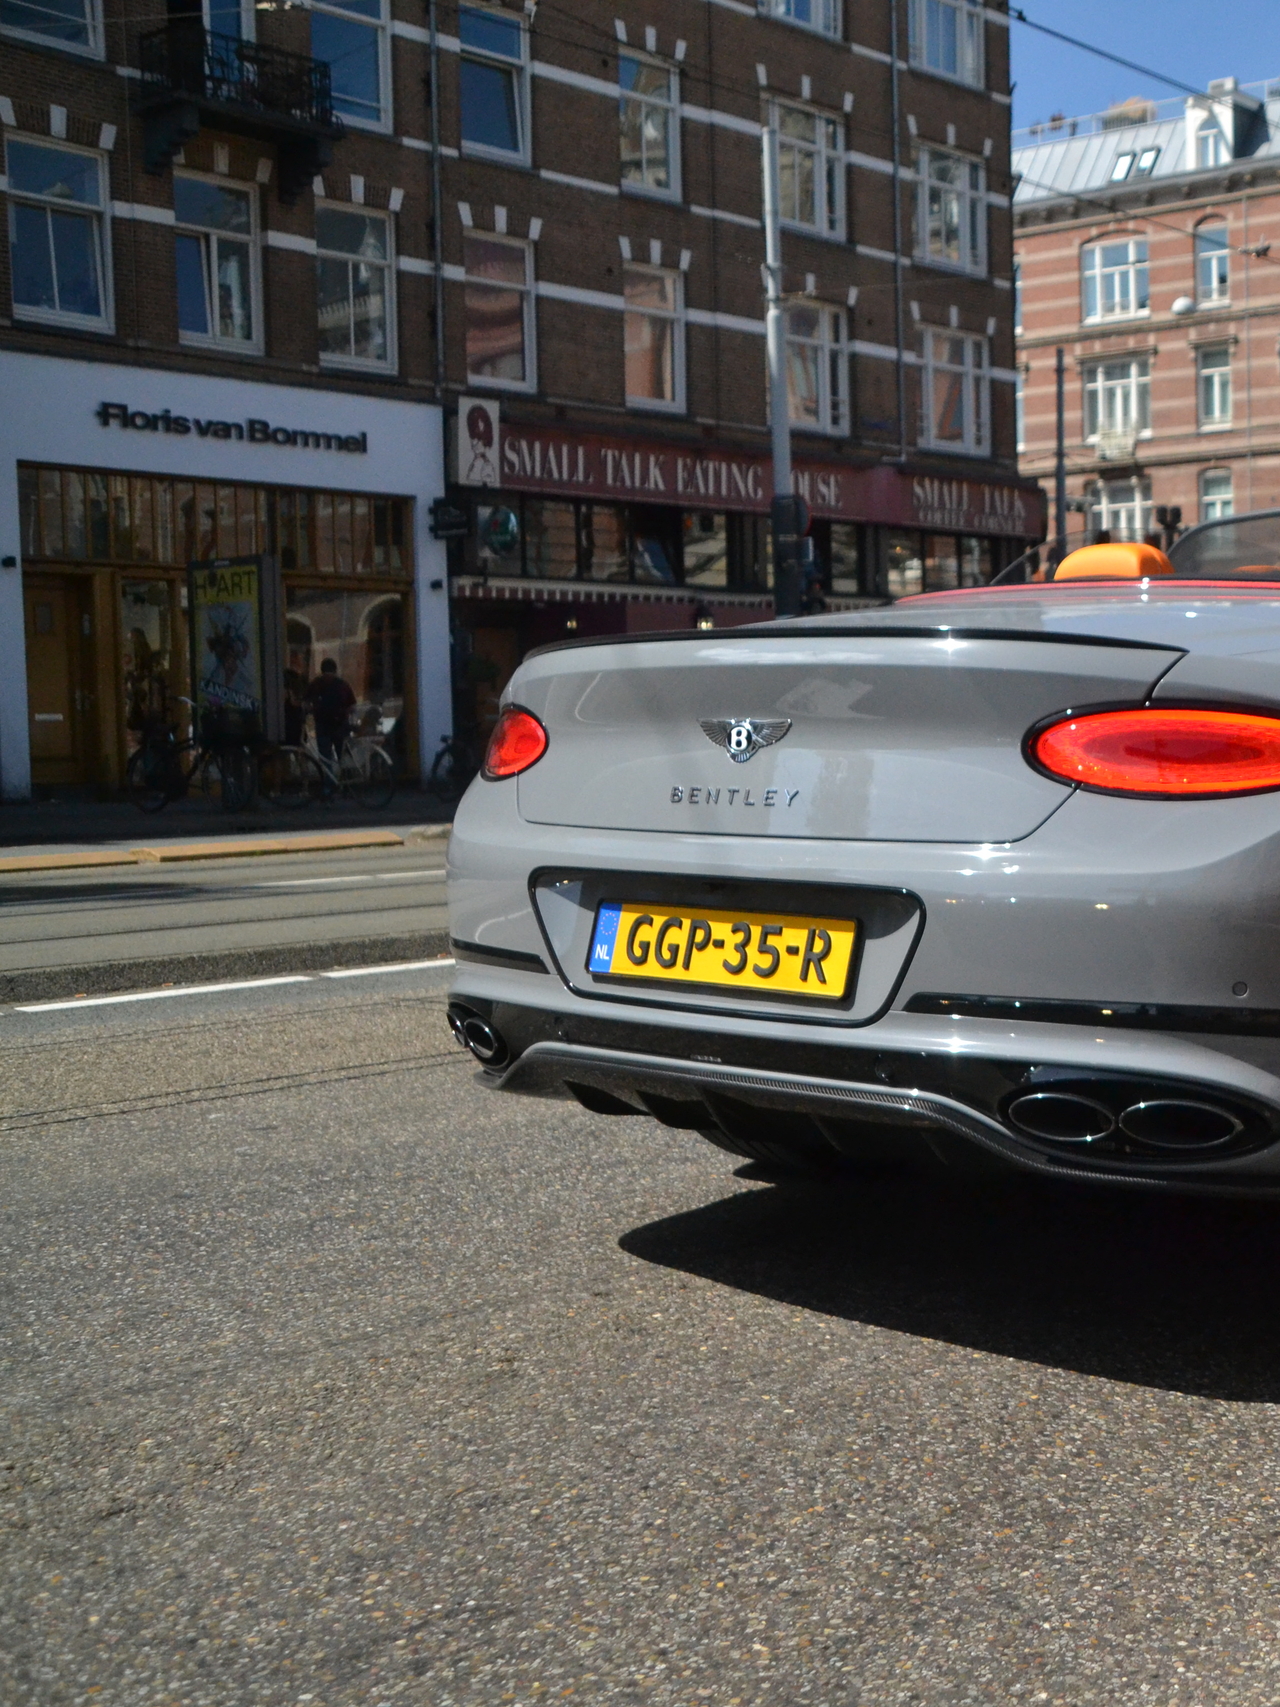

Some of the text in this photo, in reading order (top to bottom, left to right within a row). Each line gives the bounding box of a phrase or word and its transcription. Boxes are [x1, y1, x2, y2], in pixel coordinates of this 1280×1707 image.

[96, 401, 368, 454] Floris van Bommel
[504, 436, 842, 508] SMALL TALK EATING OUSE
[912, 476, 1026, 518] SMALL TALK
[669, 785, 800, 807] BENTLEY
[594, 944, 610, 960] NL
[626, 914, 832, 984] GGP-35-R
